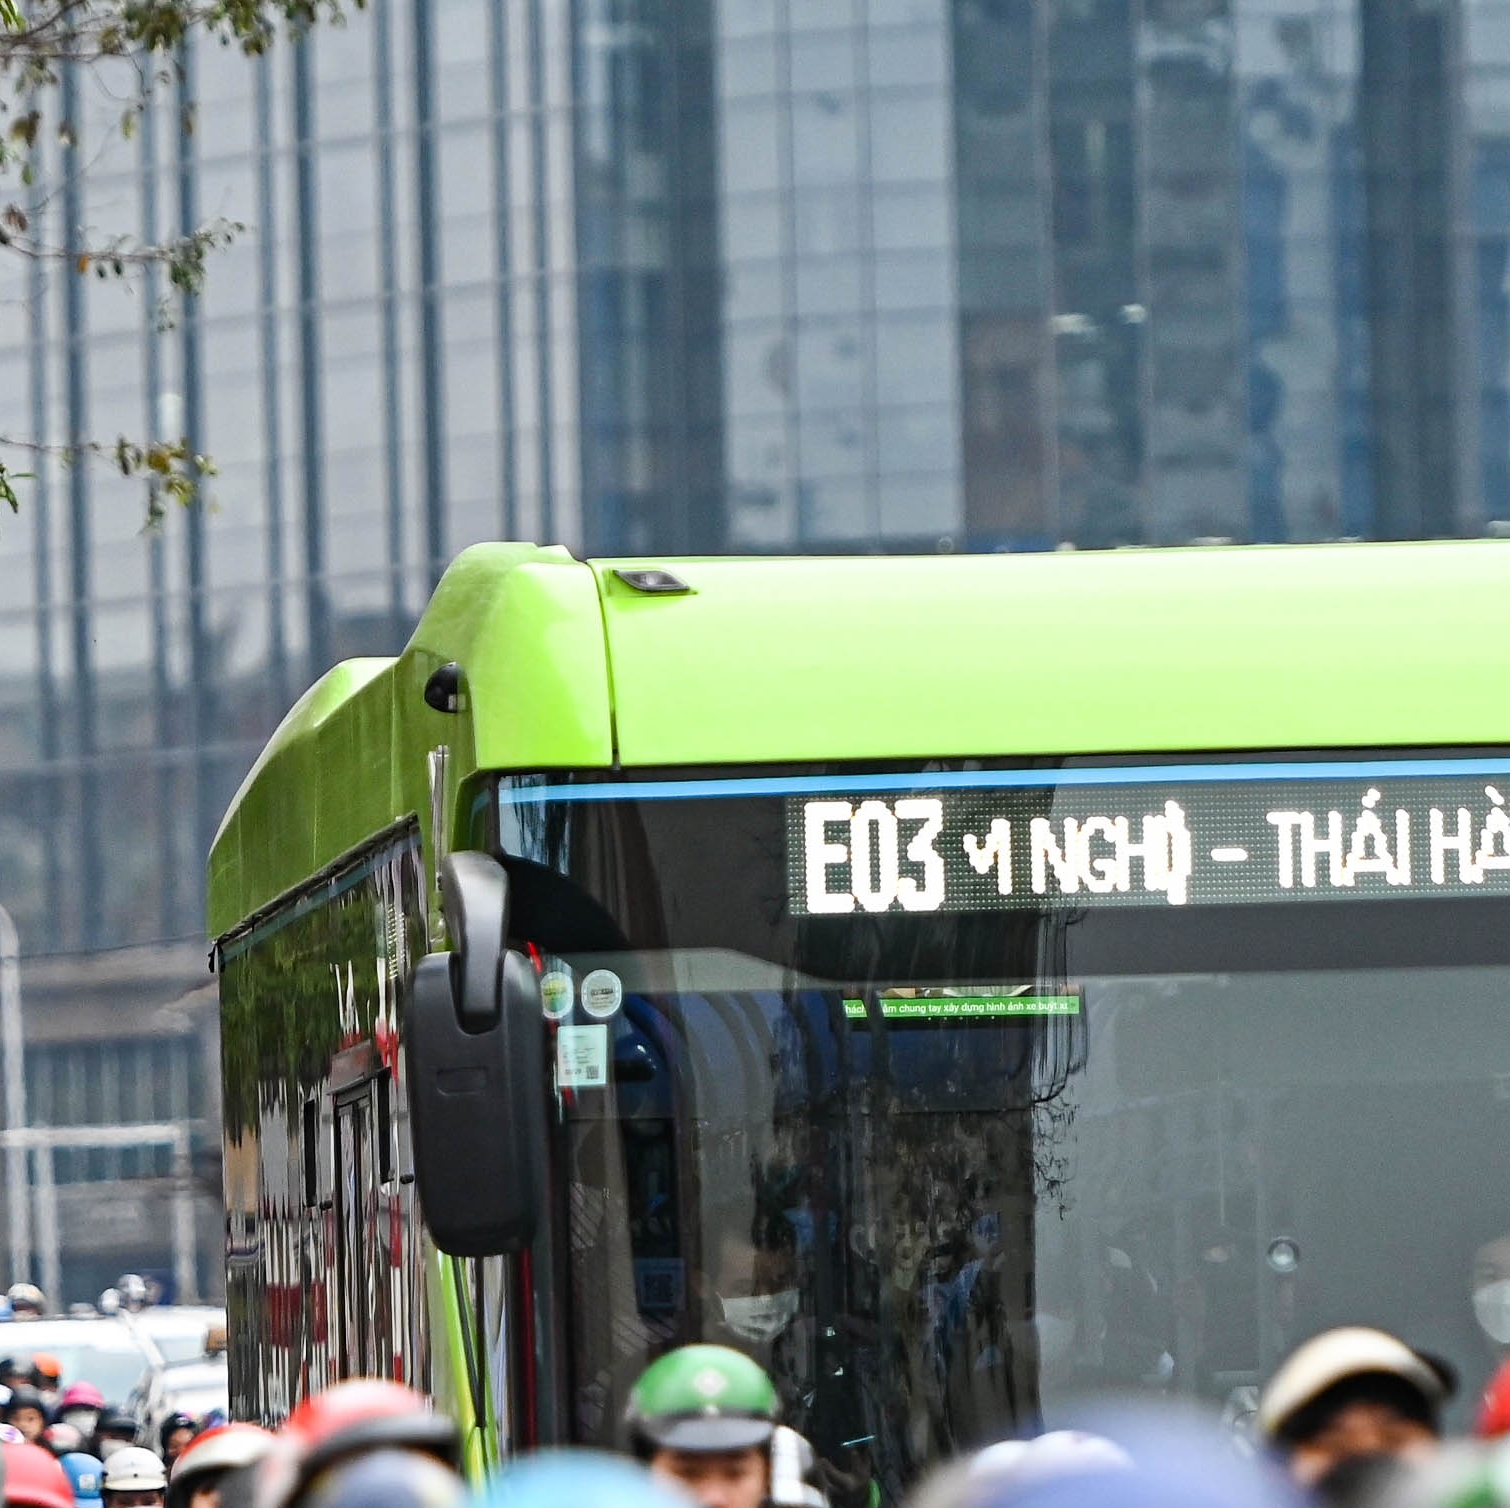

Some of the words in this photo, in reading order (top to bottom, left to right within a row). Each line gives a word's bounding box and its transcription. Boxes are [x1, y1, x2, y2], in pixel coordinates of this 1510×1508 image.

[804, 799, 945, 914] E03
[1266, 788, 1412, 888] THÁI
[898, 1004, 926, 1015] chung
[928, 1004, 942, 1015] tay
[943, 1004, 959, 1015] xây
[961, 1002, 984, 1014] dựng
[986, 1002, 1006, 1012] hình
[1007, 1001, 1024, 1011] ảnh
